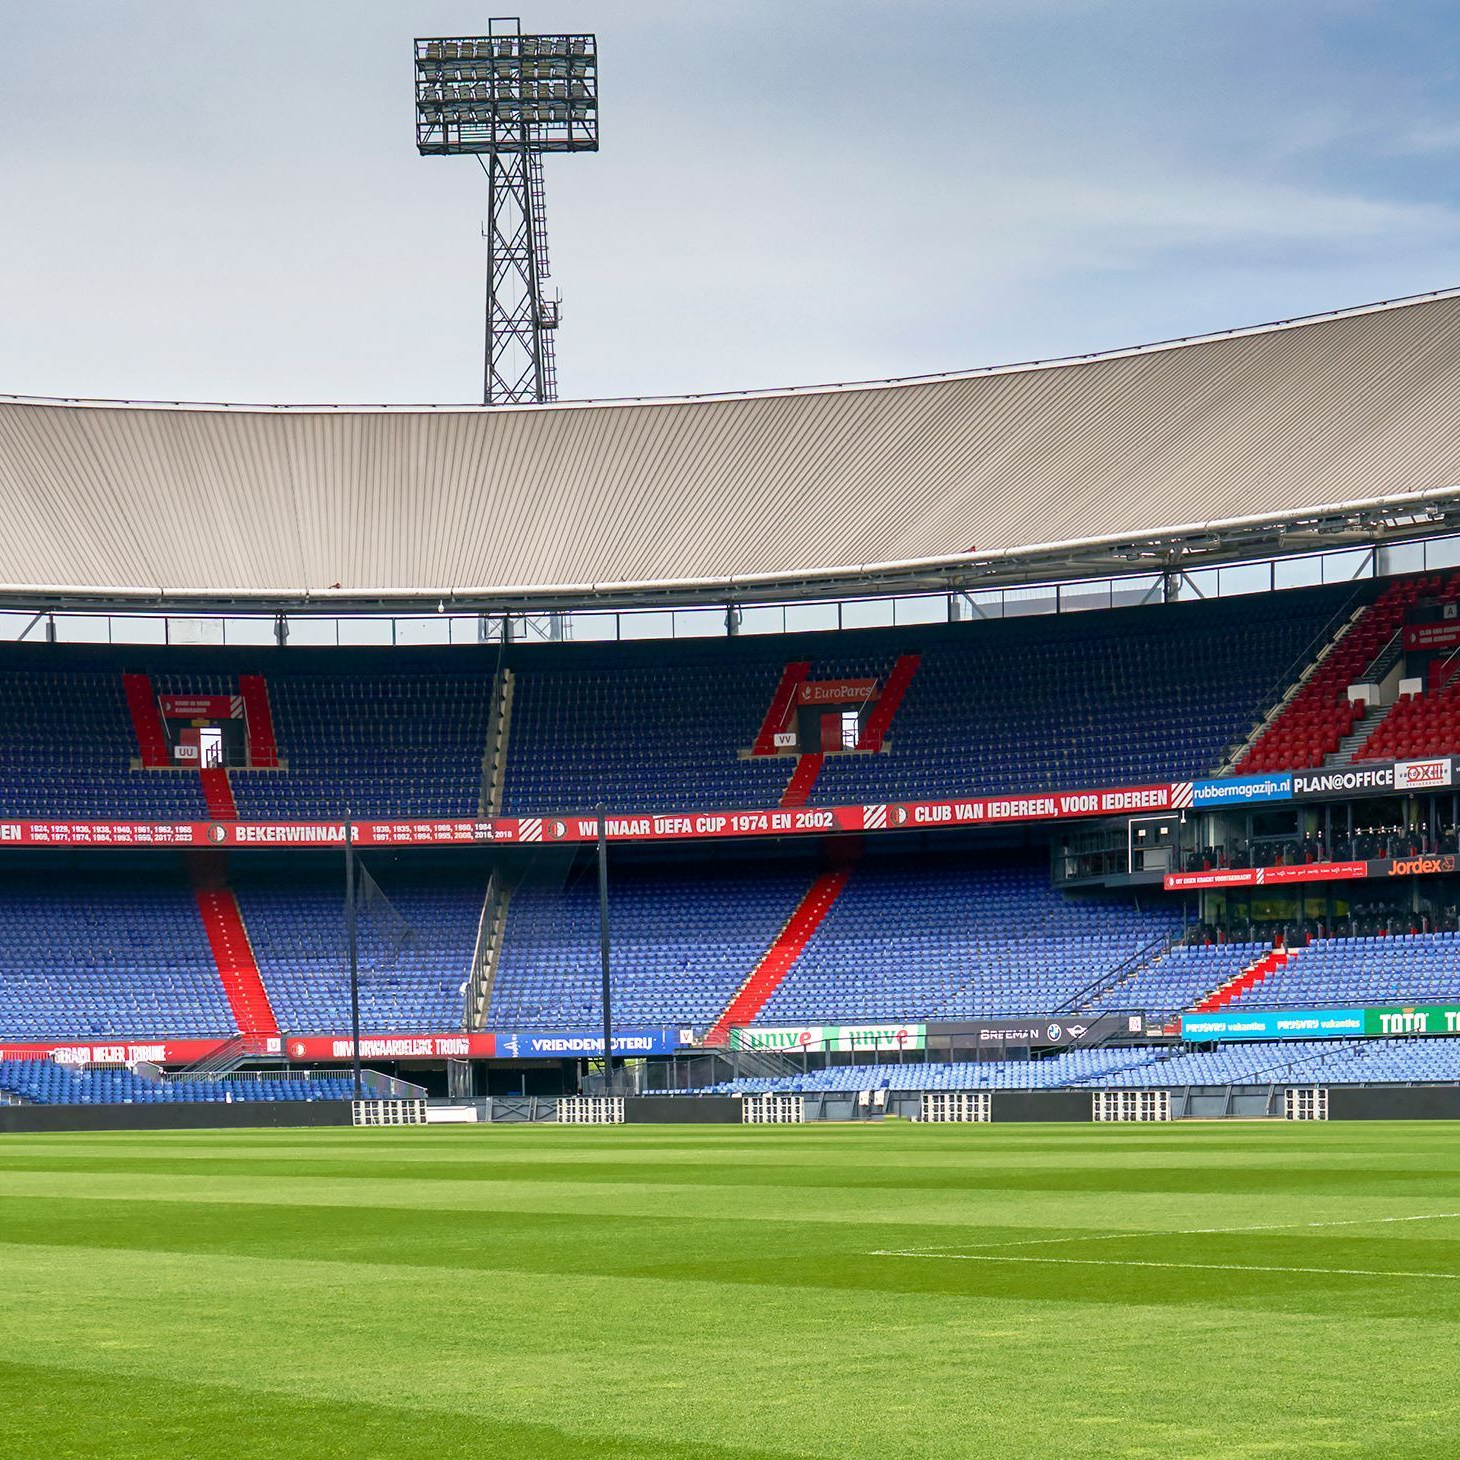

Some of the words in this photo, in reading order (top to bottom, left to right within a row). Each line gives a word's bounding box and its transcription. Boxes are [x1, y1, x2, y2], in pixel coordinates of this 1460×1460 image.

[814, 685, 872, 699] EuroParcs
[778, 735, 792, 744] VV
[179, 748, 193, 756] UU
[1194, 779, 1291, 800] rubbermagazijn.nl
[1294, 771, 1393, 792] PLAN@OFFICE
[915, 807, 951, 822] CLUB
[955, 804, 984, 820] VAN
[988, 798, 1059, 818] IEDEREEN,
[1061, 796, 1098, 813] VOOR
[1102, 790, 1168, 809] IEDEREEN
[654, 817, 692, 834] UEFA
[696, 816, 726, 832] CUP
[731, 815, 768, 831] 1974
[772, 814, 791, 829] EN
[796, 811, 833, 827] 2002
[235, 826, 359, 841] BEKERWINNAAR
[1388, 857, 1442, 876] Jordex
[1228, 1021, 1266, 1032] vakanties
[1320, 1018, 1360, 1029] vakanties
[1379, 1012, 1429, 1034] TOTO
[980, 1029, 1039, 1040] BREEMAN
[93, 1046, 125, 1063] MEIJER
[127, 1045, 166, 1062] TRIBUNE
[333, 1039, 433, 1057] ONVORWAARDELIJKE
[435, 1037, 470, 1056] TROUW
